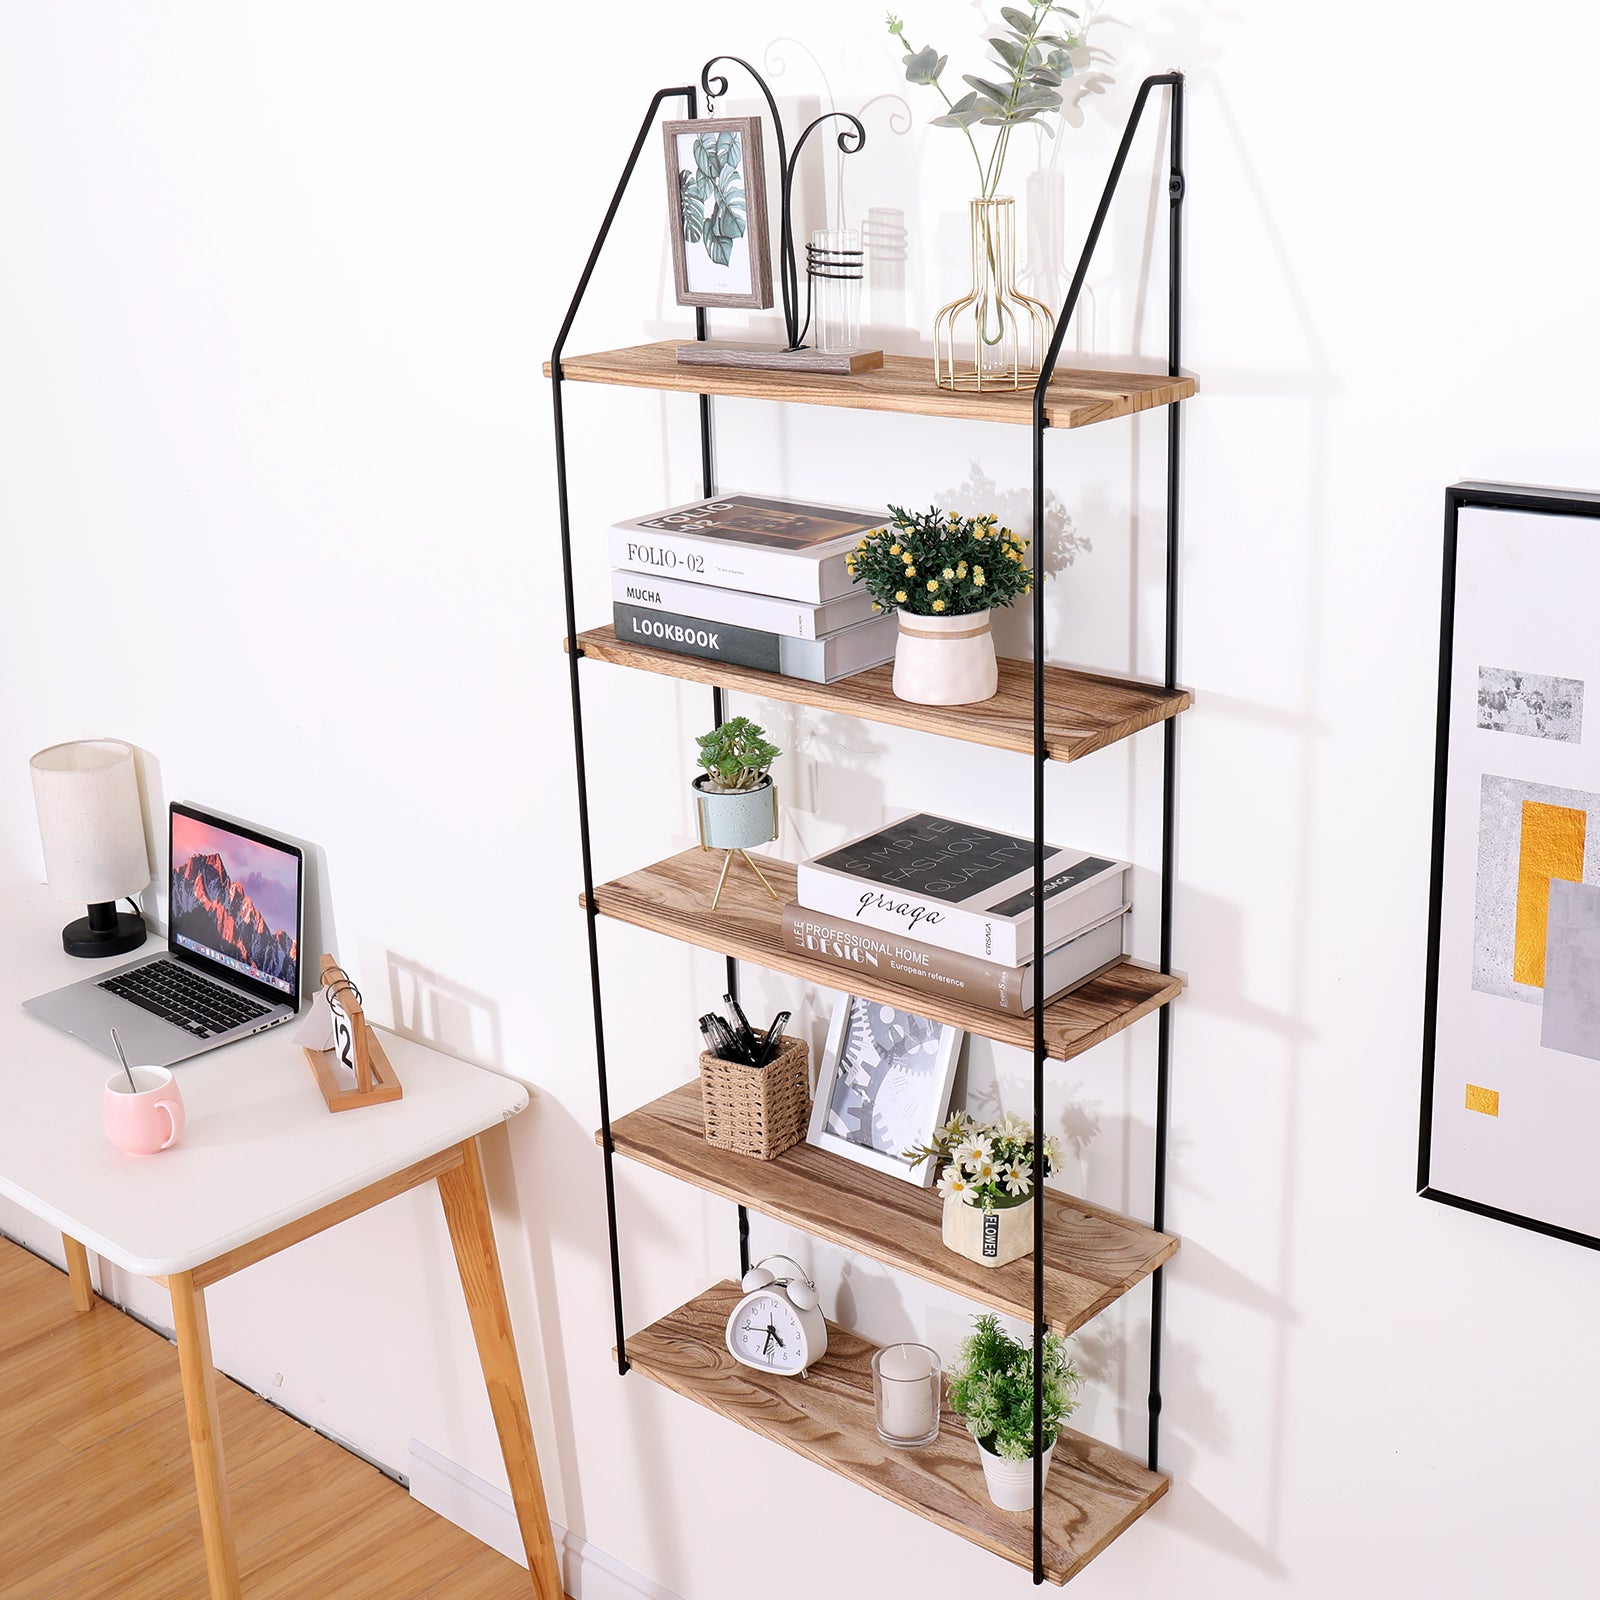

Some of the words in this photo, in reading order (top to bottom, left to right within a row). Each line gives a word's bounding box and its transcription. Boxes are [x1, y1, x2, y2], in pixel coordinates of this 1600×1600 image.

[643, 503, 734, 528] FOLIO
[626, 586, 662, 604] MUCHA
[632, 617, 720, 650] LOOKBOOK
[845, 822, 955, 871] SIMPLE
[881, 832, 992, 882] FASHION
[924, 841, 1027, 892] QUALITY
[806, 923, 892, 956] PROFESSIONAL
[895, 947, 930, 966] HOME
[806, 934, 879, 968] DESIGN
[890, 960, 927, 978] European
[927, 971, 965, 988] reference
[984, 1216, 997, 1255] FLOWER
